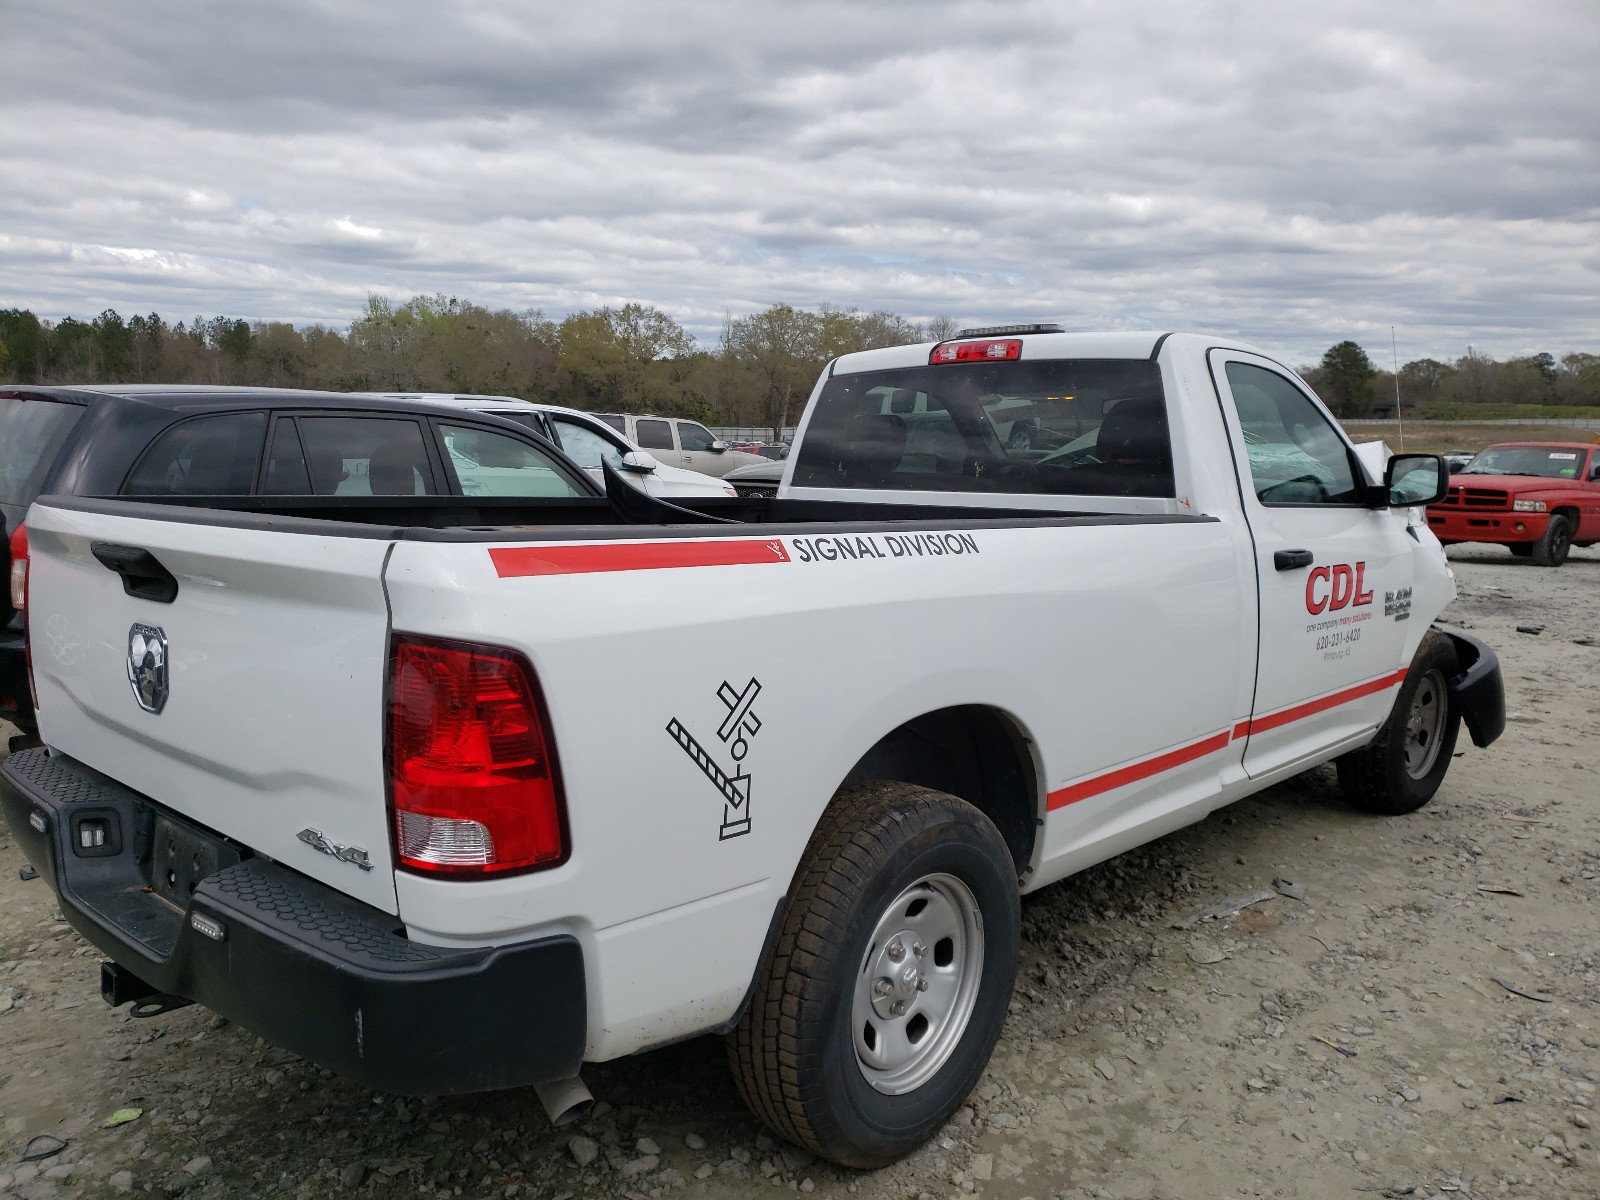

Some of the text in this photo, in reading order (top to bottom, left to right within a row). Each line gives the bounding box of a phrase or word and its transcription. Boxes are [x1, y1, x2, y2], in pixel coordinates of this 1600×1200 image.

[792, 533, 980, 562] SIGNAL DIVISION
[1306, 561, 1374, 615] CDL
[1316, 619, 1338, 630] company
[1352, 612, 1372, 623] solutions
[1316, 628, 1361, 650] 620-231-6420
